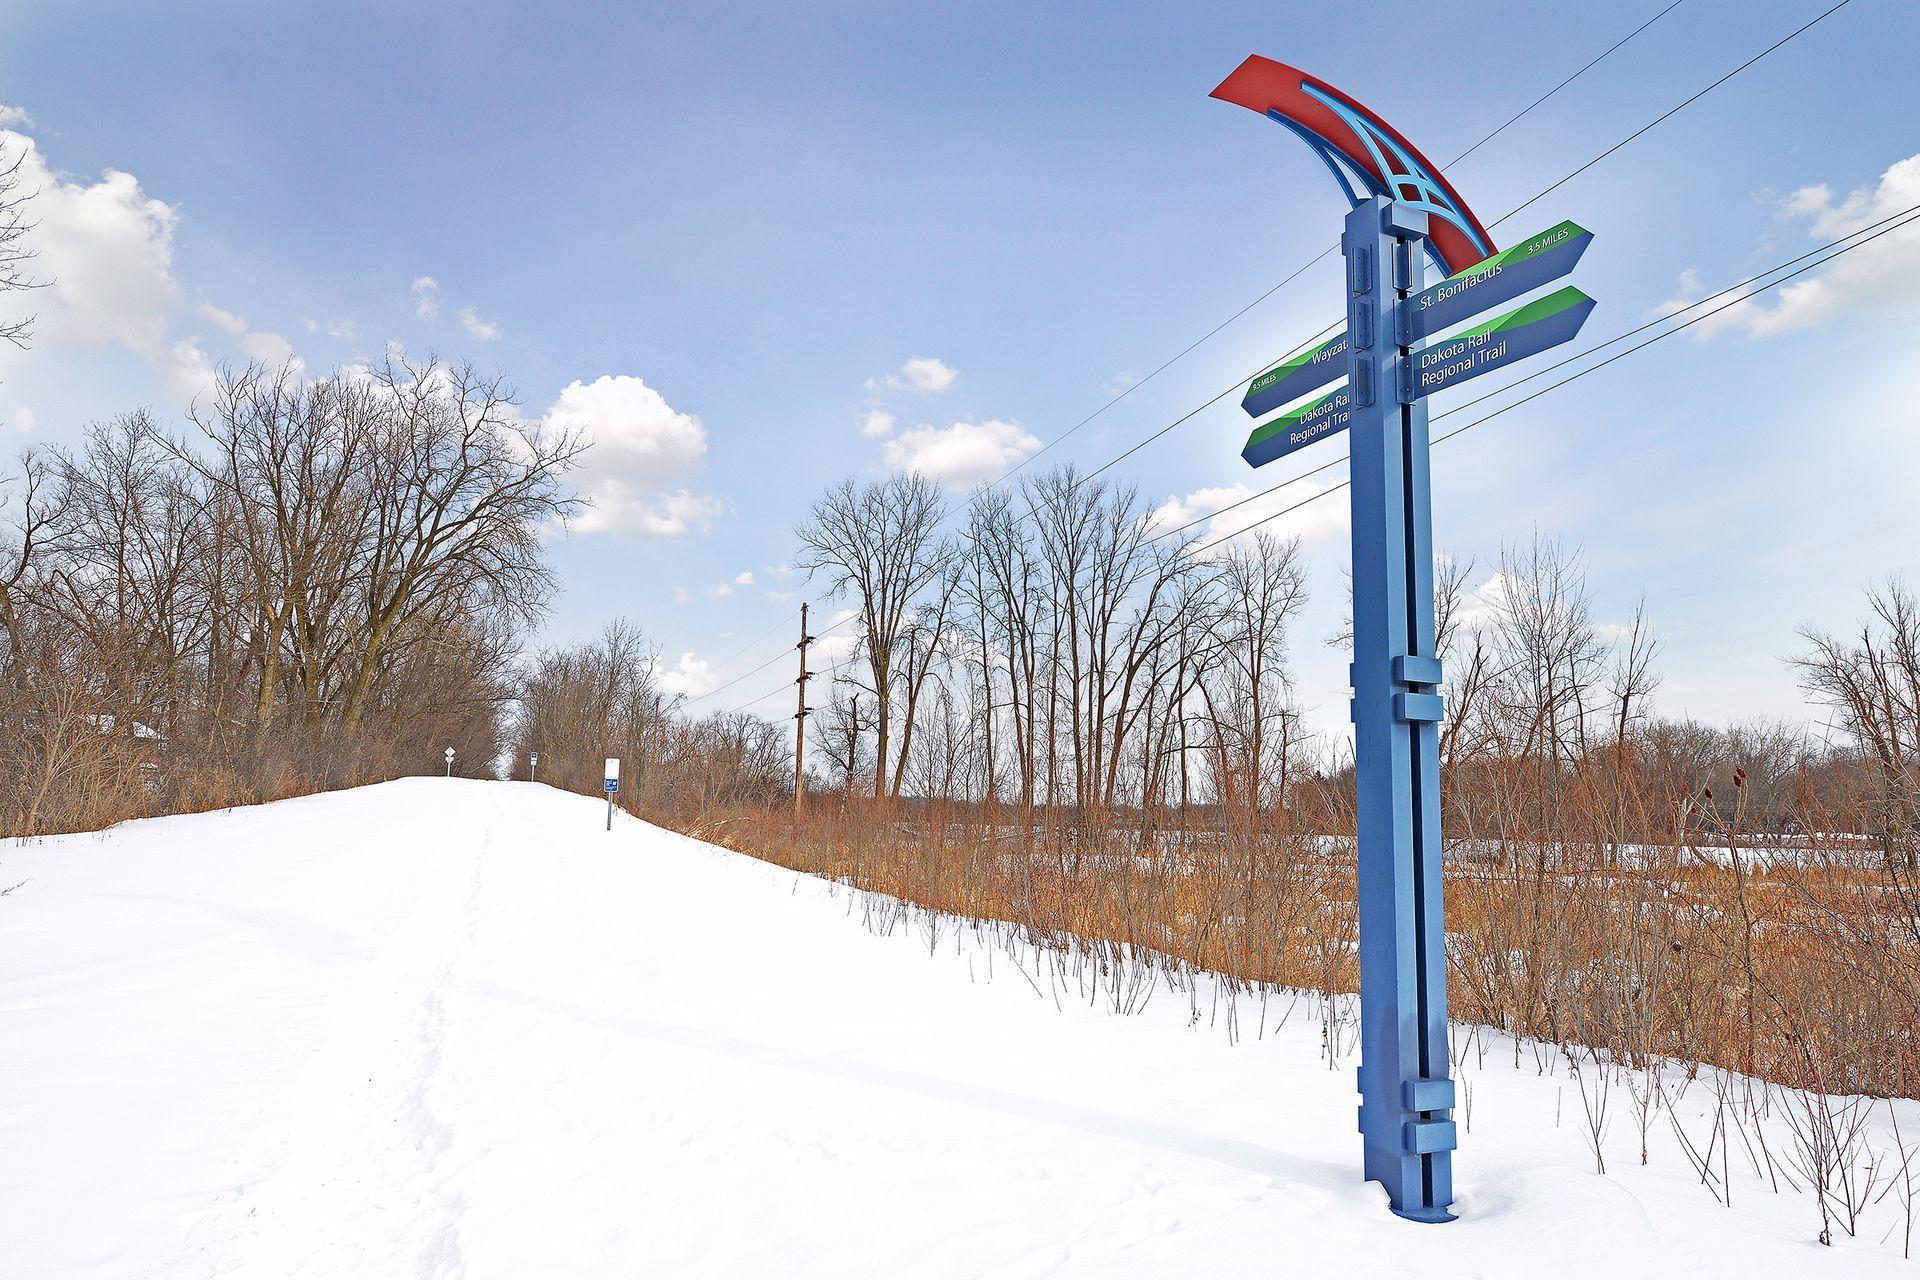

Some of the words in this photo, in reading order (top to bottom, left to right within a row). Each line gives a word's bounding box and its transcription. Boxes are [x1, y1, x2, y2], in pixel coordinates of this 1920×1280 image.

[1527, 240, 1540, 255] 3.5
[1542, 228, 1569, 247] MILES
[1420, 295, 1434, 311] St.
[1437, 262, 1503, 300] Bonifacius
[1312, 339, 1348, 365] Wayzat
[1421, 343, 1464, 369] Dakota
[1468, 328, 1492, 348] Rail
[1421, 358, 1475, 387] Regional
[1478, 341, 1507, 364] Trail
[1261, 373, 1277, 386] MILES
[1300, 401, 1333, 425] Dakota
[1335, 391, 1350, 408] Rai
[1290, 415, 1331, 445] Regional
[1332, 408, 1350, 426] Trai
